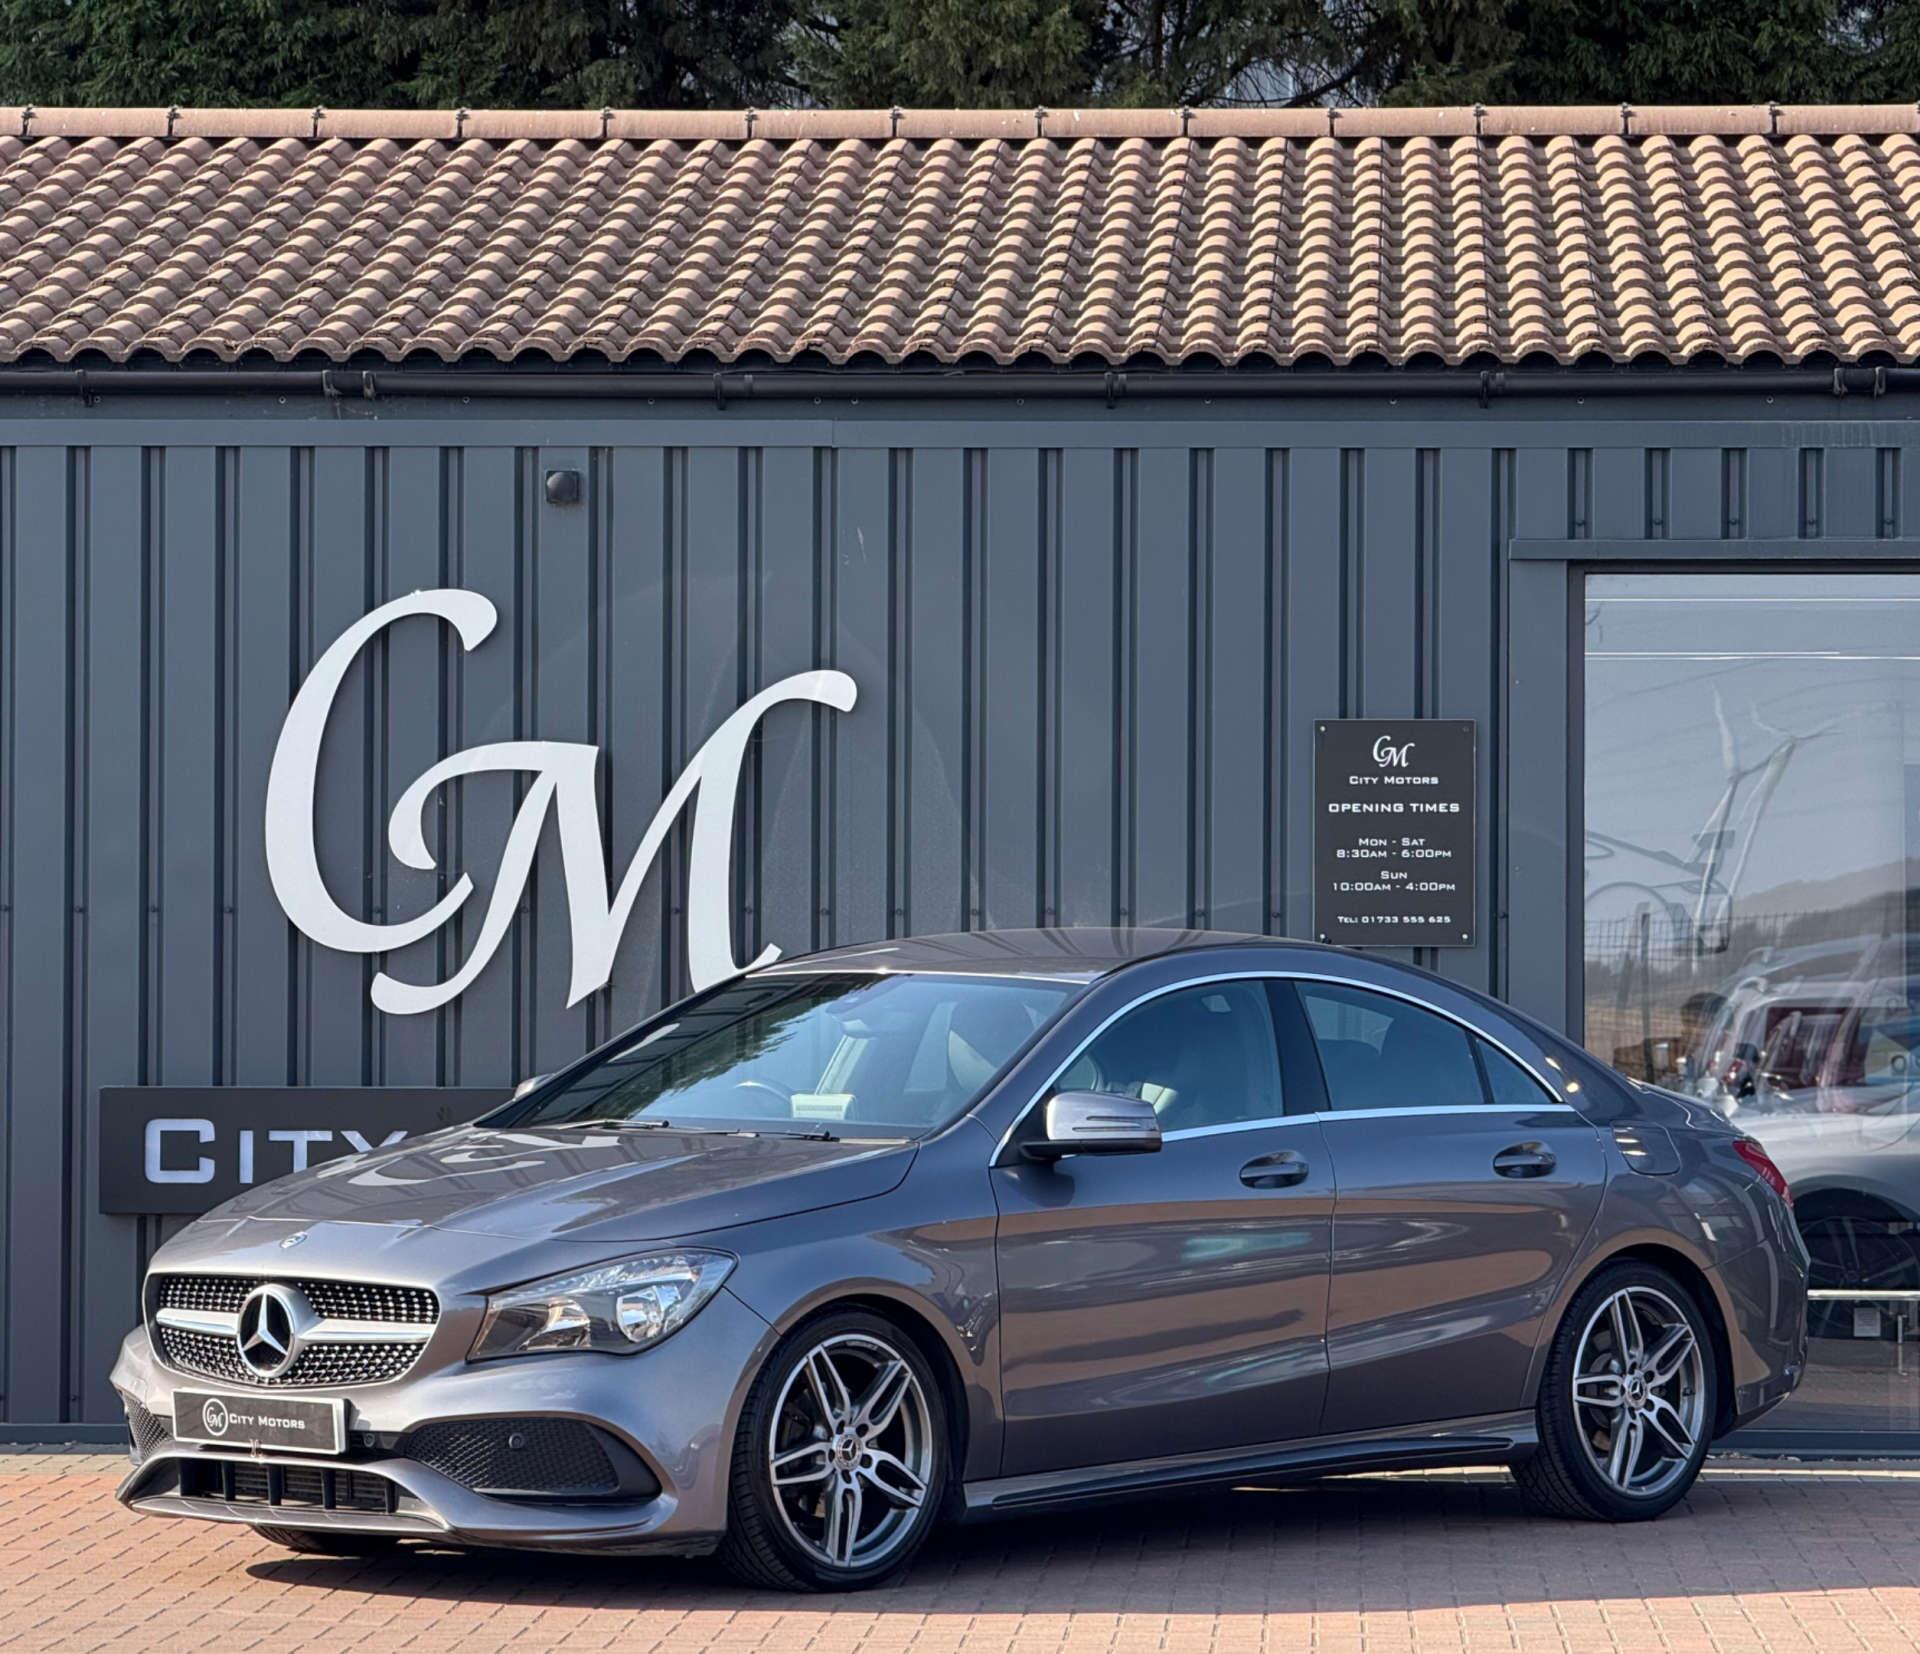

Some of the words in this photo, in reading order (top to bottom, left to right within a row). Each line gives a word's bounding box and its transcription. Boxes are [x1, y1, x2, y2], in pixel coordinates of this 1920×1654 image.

[1328, 802, 1404, 813] OPENING
[1409, 802, 1460, 813] TIMES
[1361, 915, 1399, 924] 01733
[1402, 915, 1425, 924] 555
[1428, 915, 1452, 924] 625
